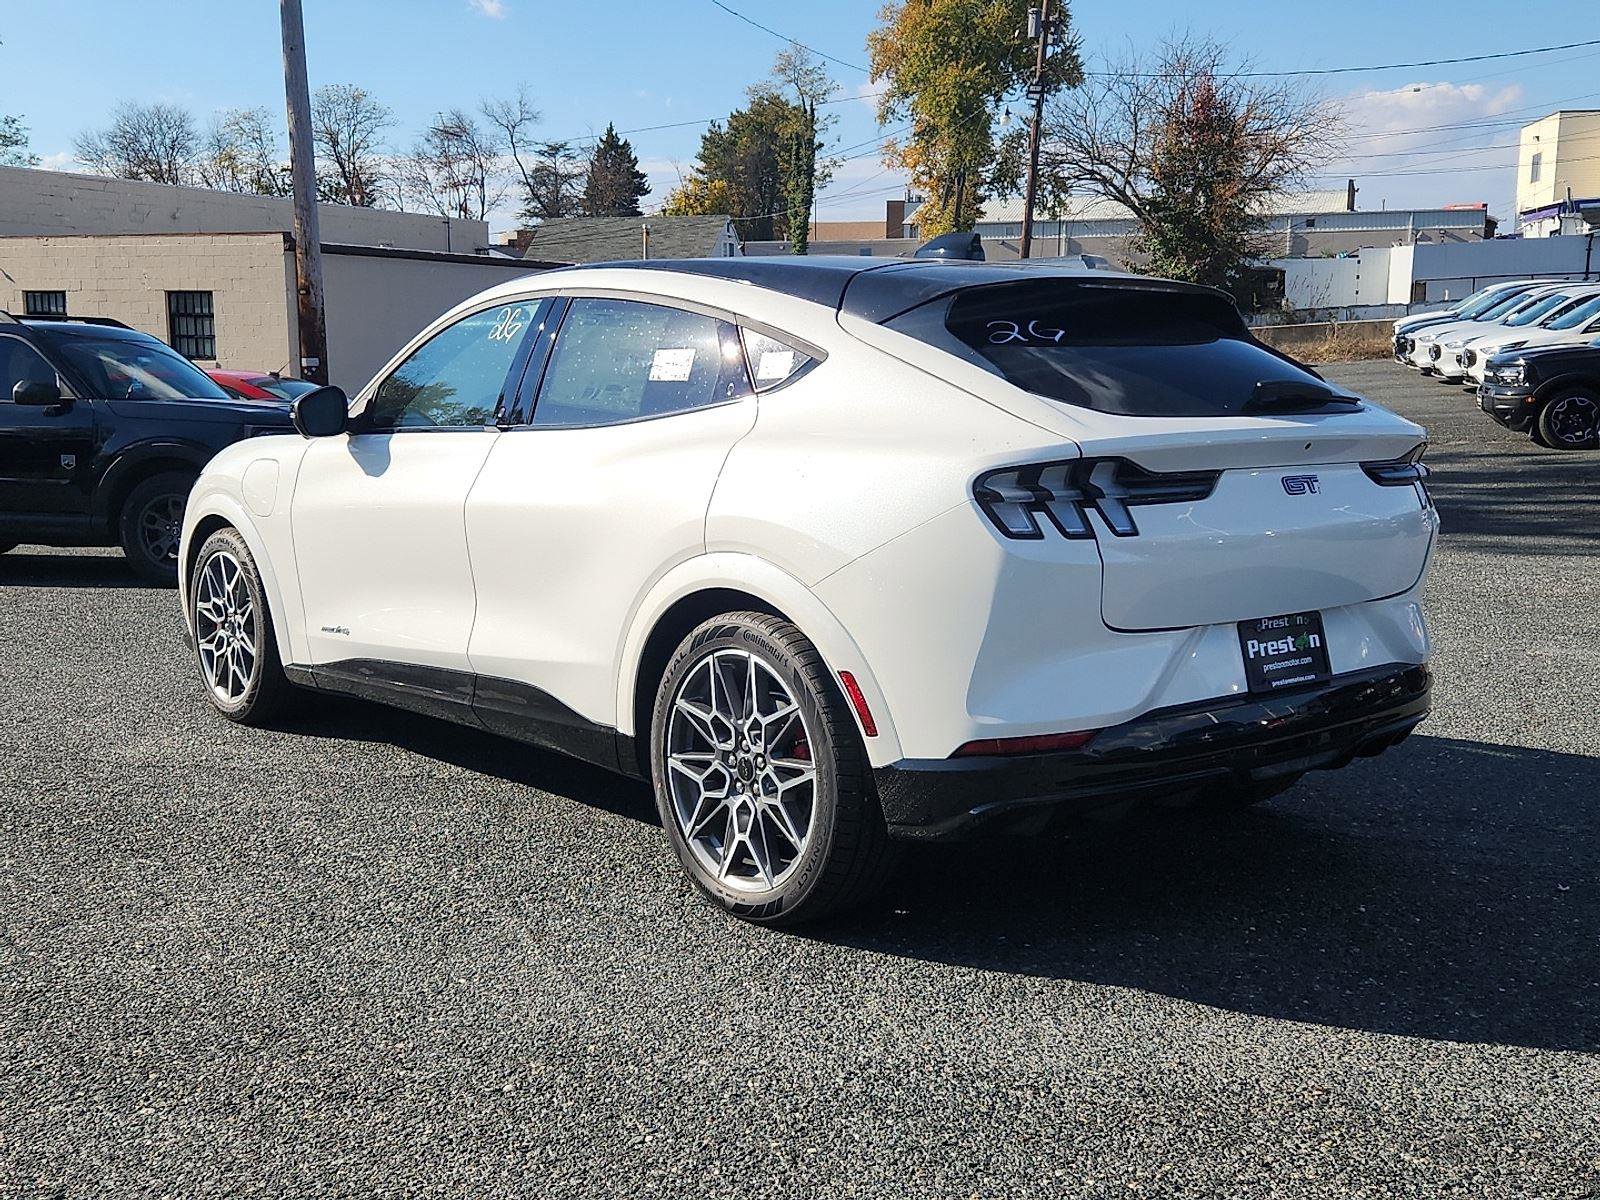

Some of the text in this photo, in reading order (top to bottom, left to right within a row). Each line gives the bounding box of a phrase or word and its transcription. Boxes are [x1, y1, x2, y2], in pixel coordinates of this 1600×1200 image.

[1281, 474, 1319, 496] GT
[743, 629, 785, 663] Continental
[1263, 656, 1313, 674] prestonmotor.com
